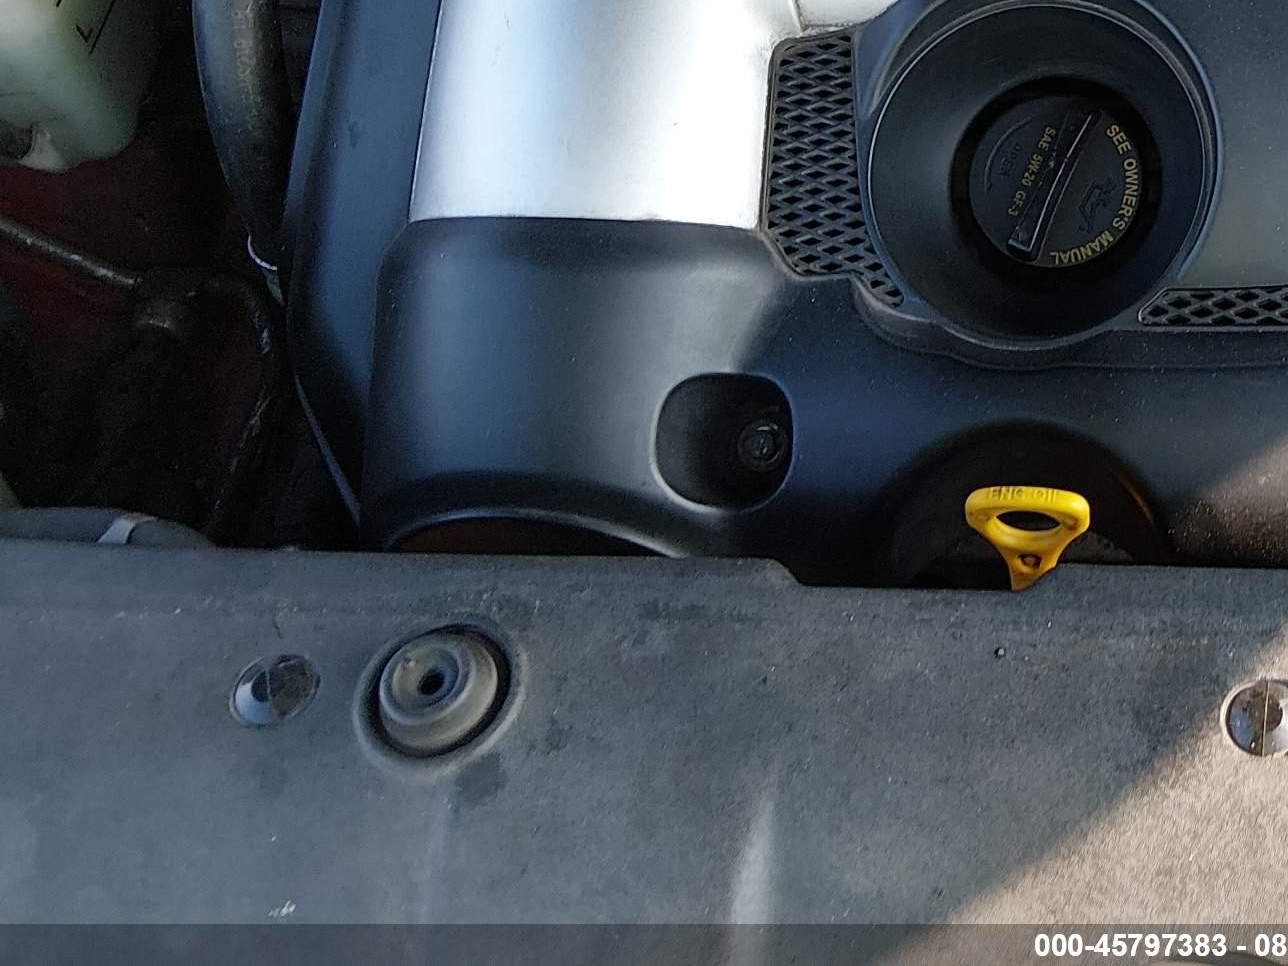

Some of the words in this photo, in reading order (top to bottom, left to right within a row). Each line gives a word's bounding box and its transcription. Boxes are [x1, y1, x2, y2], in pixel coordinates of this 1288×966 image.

[76, 25, 93, 43] L
[1038, 126, 1057, 152] SAE
[1106, 124, 1132, 155] SEE
[1022, 153, 1045, 187] 5W-20
[1007, 190, 1027, 217] GF-3
[1112, 157, 1139, 231] OWNER'S
[1049, 230, 1114, 265] MANUAL
